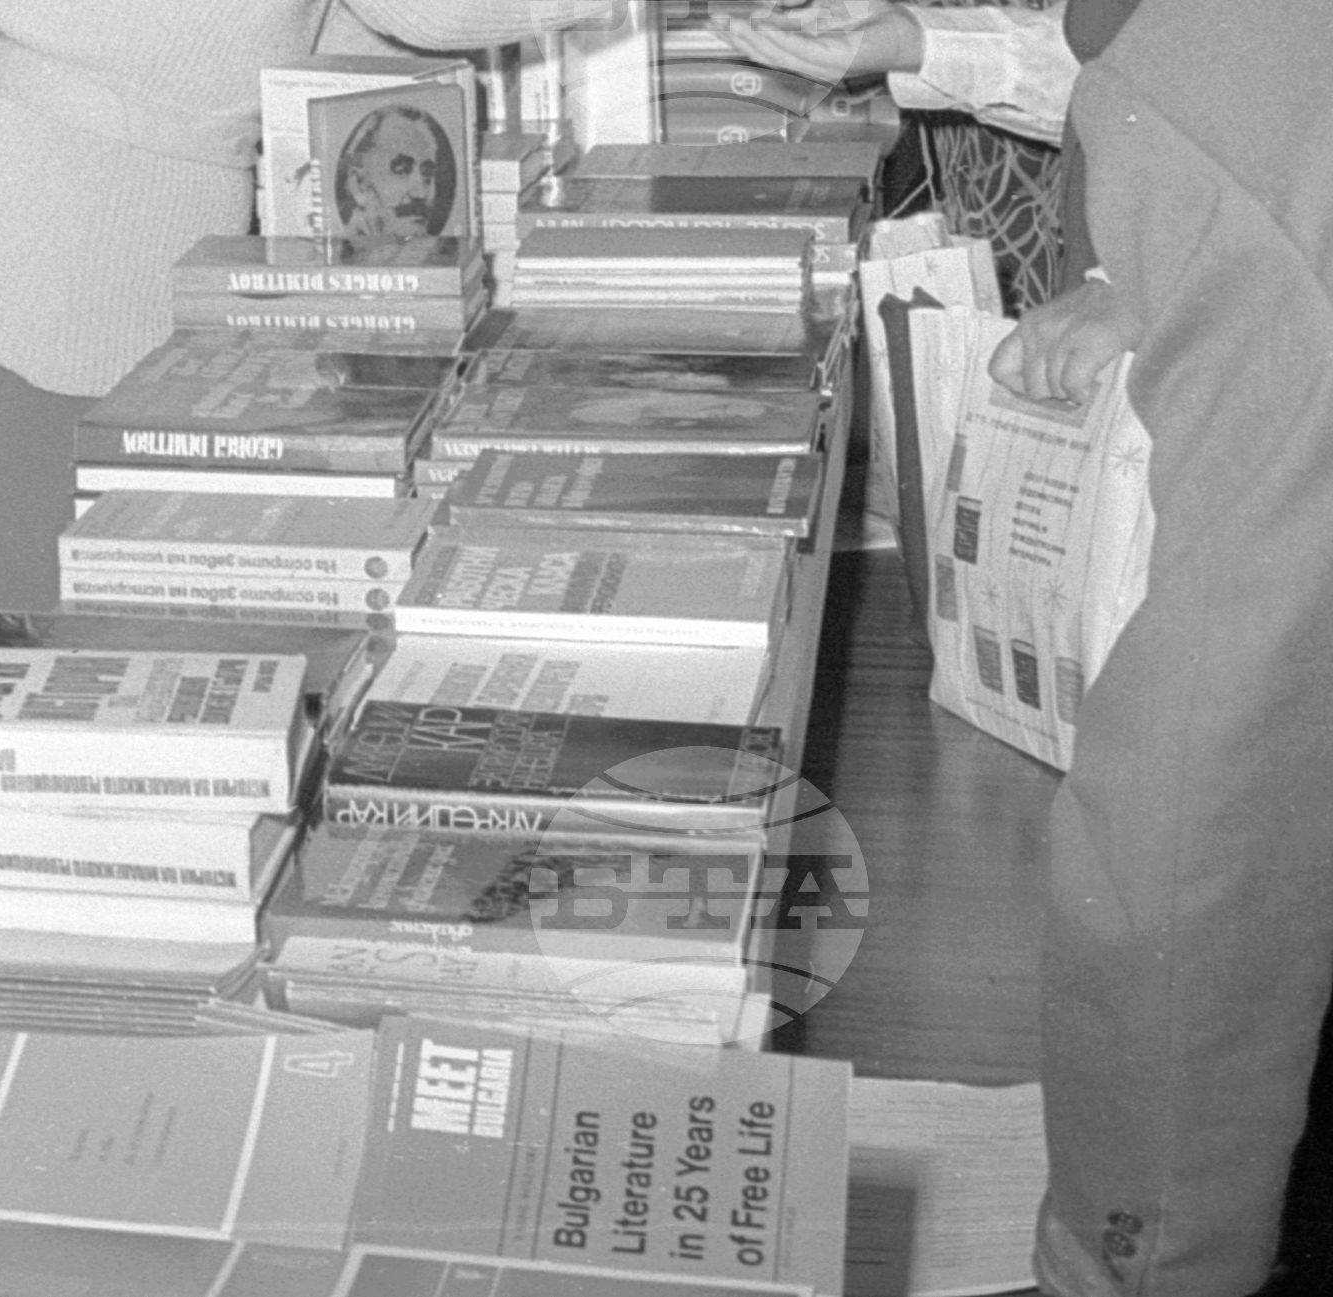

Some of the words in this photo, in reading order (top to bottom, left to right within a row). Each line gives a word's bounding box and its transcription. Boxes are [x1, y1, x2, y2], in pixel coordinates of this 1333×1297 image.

[121, 429, 209, 460] DIMITROV
[213, 432, 284, 461] GEORGI
[410, 1037, 481, 1135] MEET
[471, 1047, 514, 1139] BULGARIA
[677, 1094, 716, 1178] Years
[738, 1100, 776, 1159] Life
[553, 1109, 601, 1250] Bulgarian
[612, 1110, 658, 1256] Literature
[673, 1183, 710, 1224] 25
[730, 1165, 771, 1230] Free
[669, 1234, 705, 1262] in
[730, 1231, 765, 1268] of
